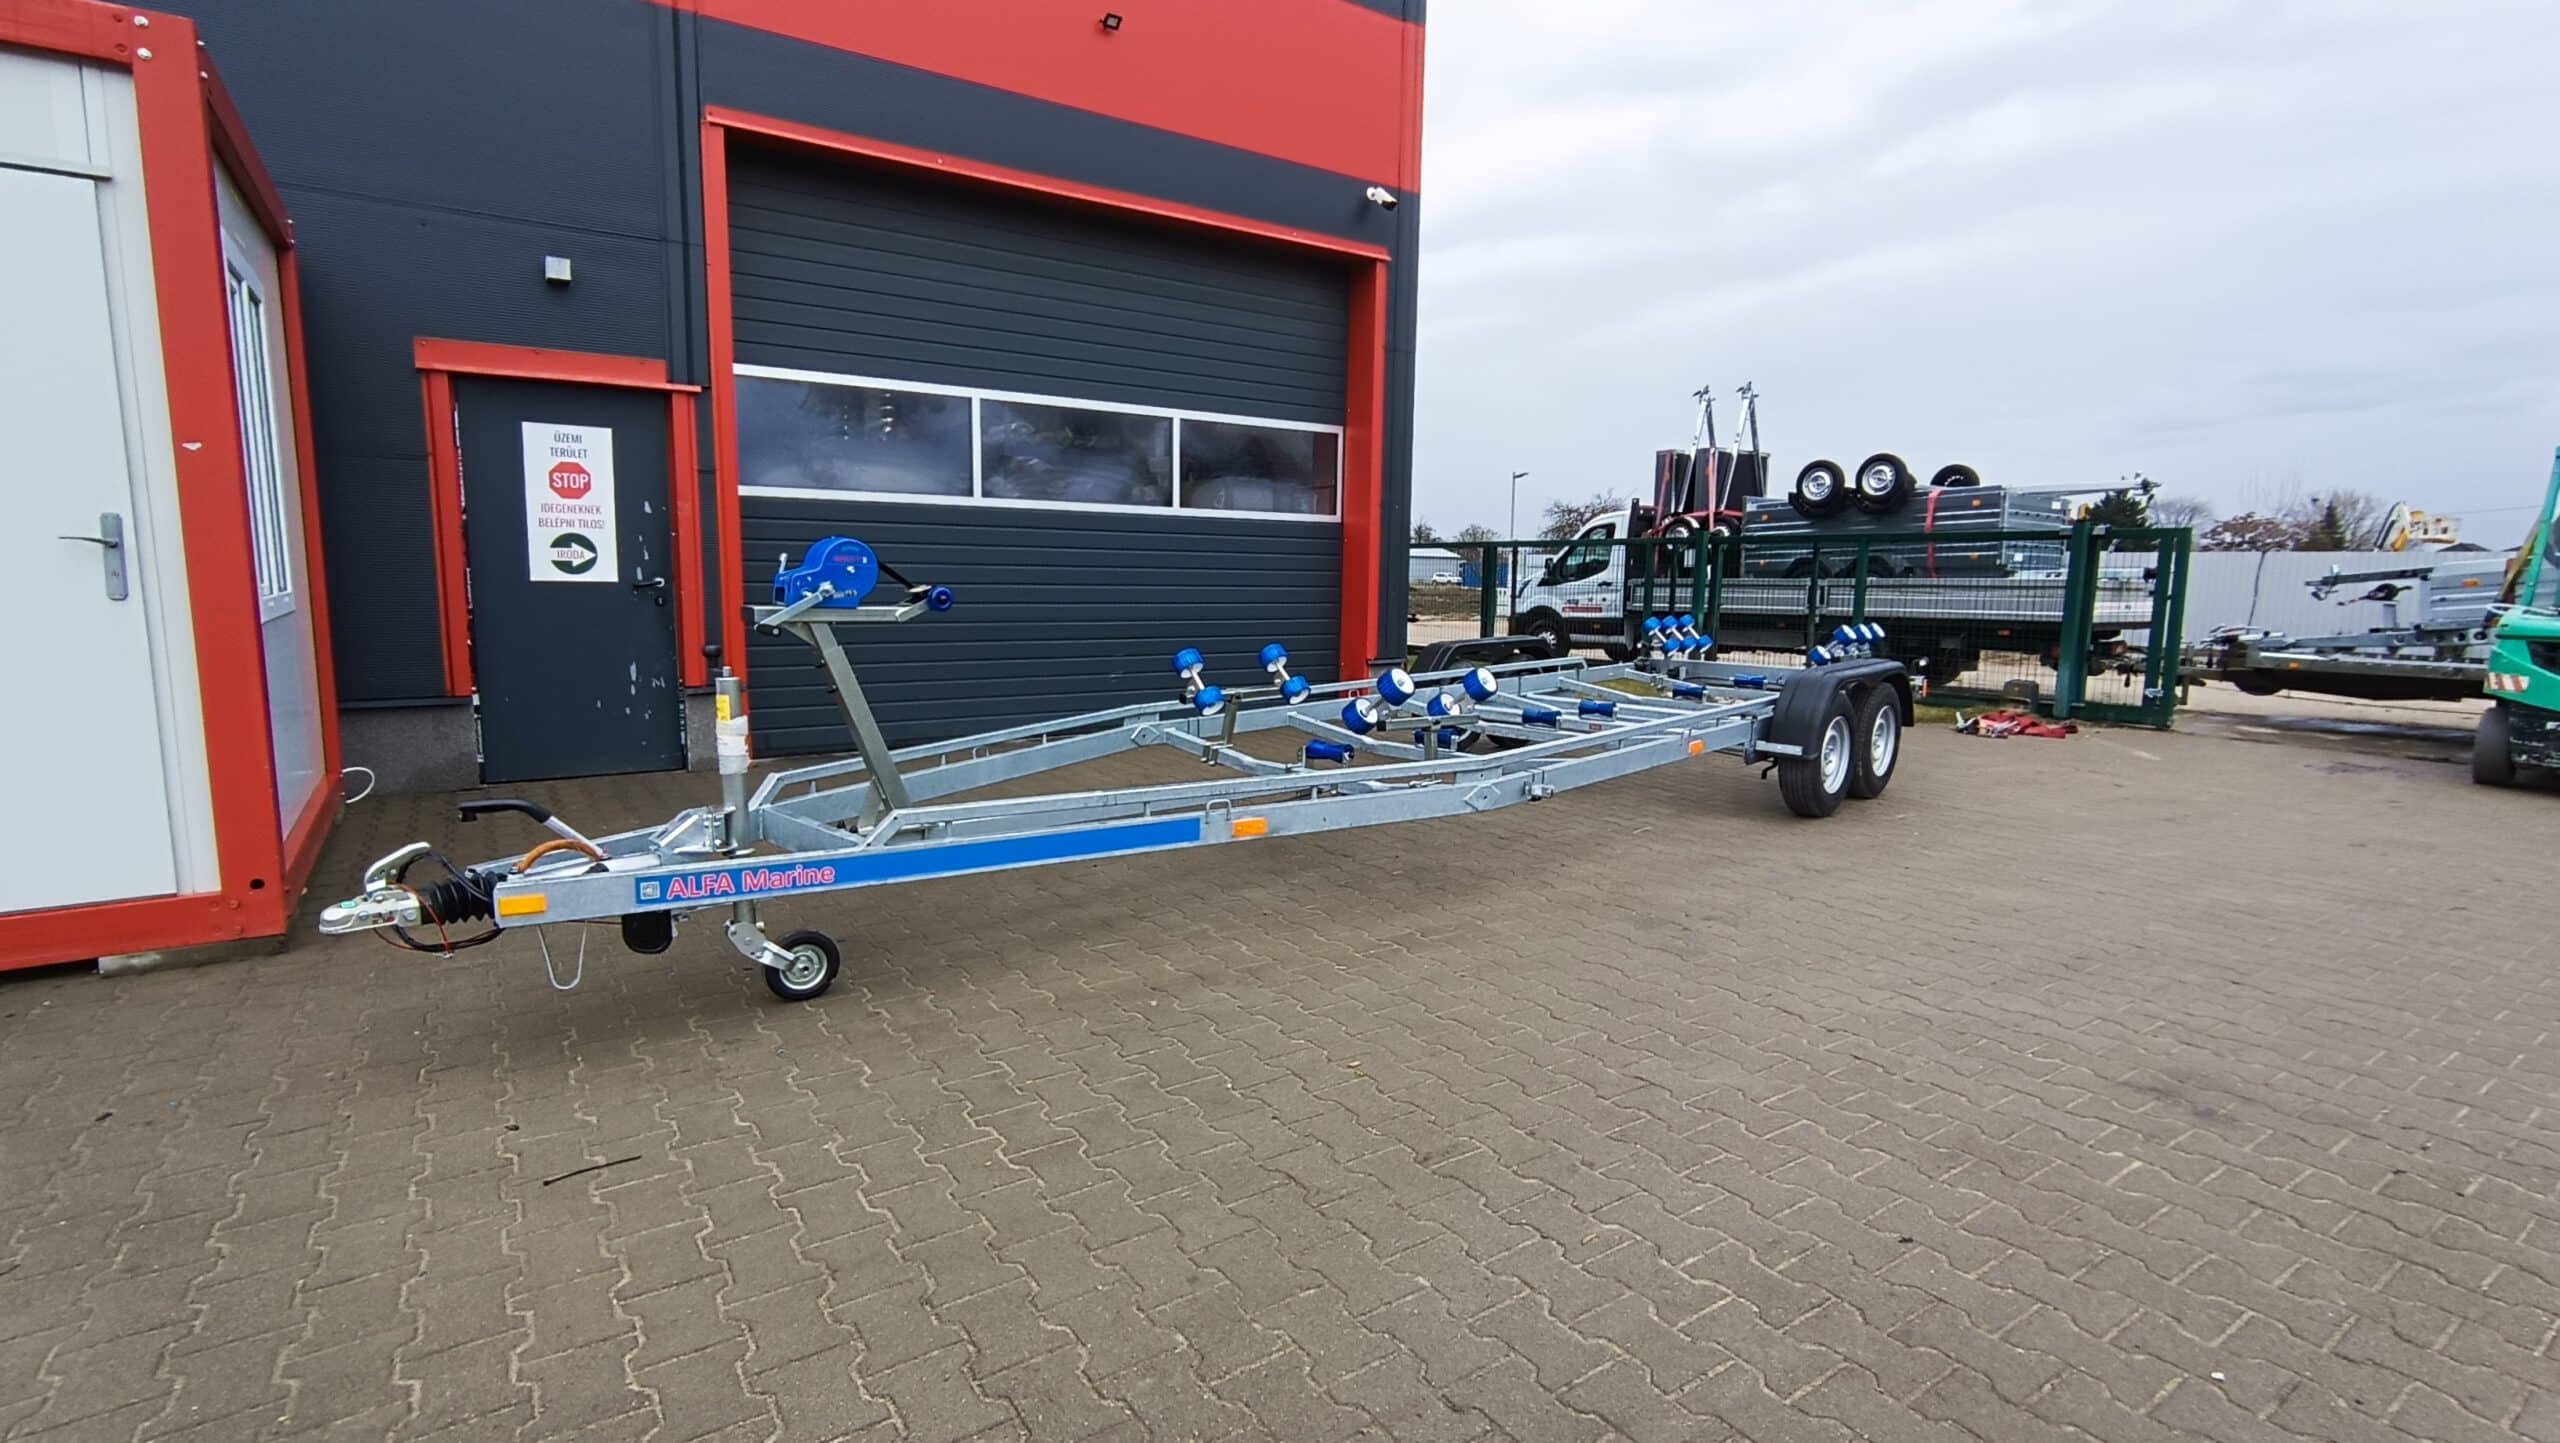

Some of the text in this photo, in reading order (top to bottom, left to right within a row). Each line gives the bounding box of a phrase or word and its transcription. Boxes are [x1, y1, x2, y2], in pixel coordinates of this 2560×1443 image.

[549, 445, 588, 459] TERÜLET
[552, 472, 589, 489] STOP
[540, 503, 602, 515] IDEGENEKNEK
[577, 518, 605, 530] TILOS!
[556, 550, 586, 560] IRODA
[667, 865, 835, 900] ALFA Marine
